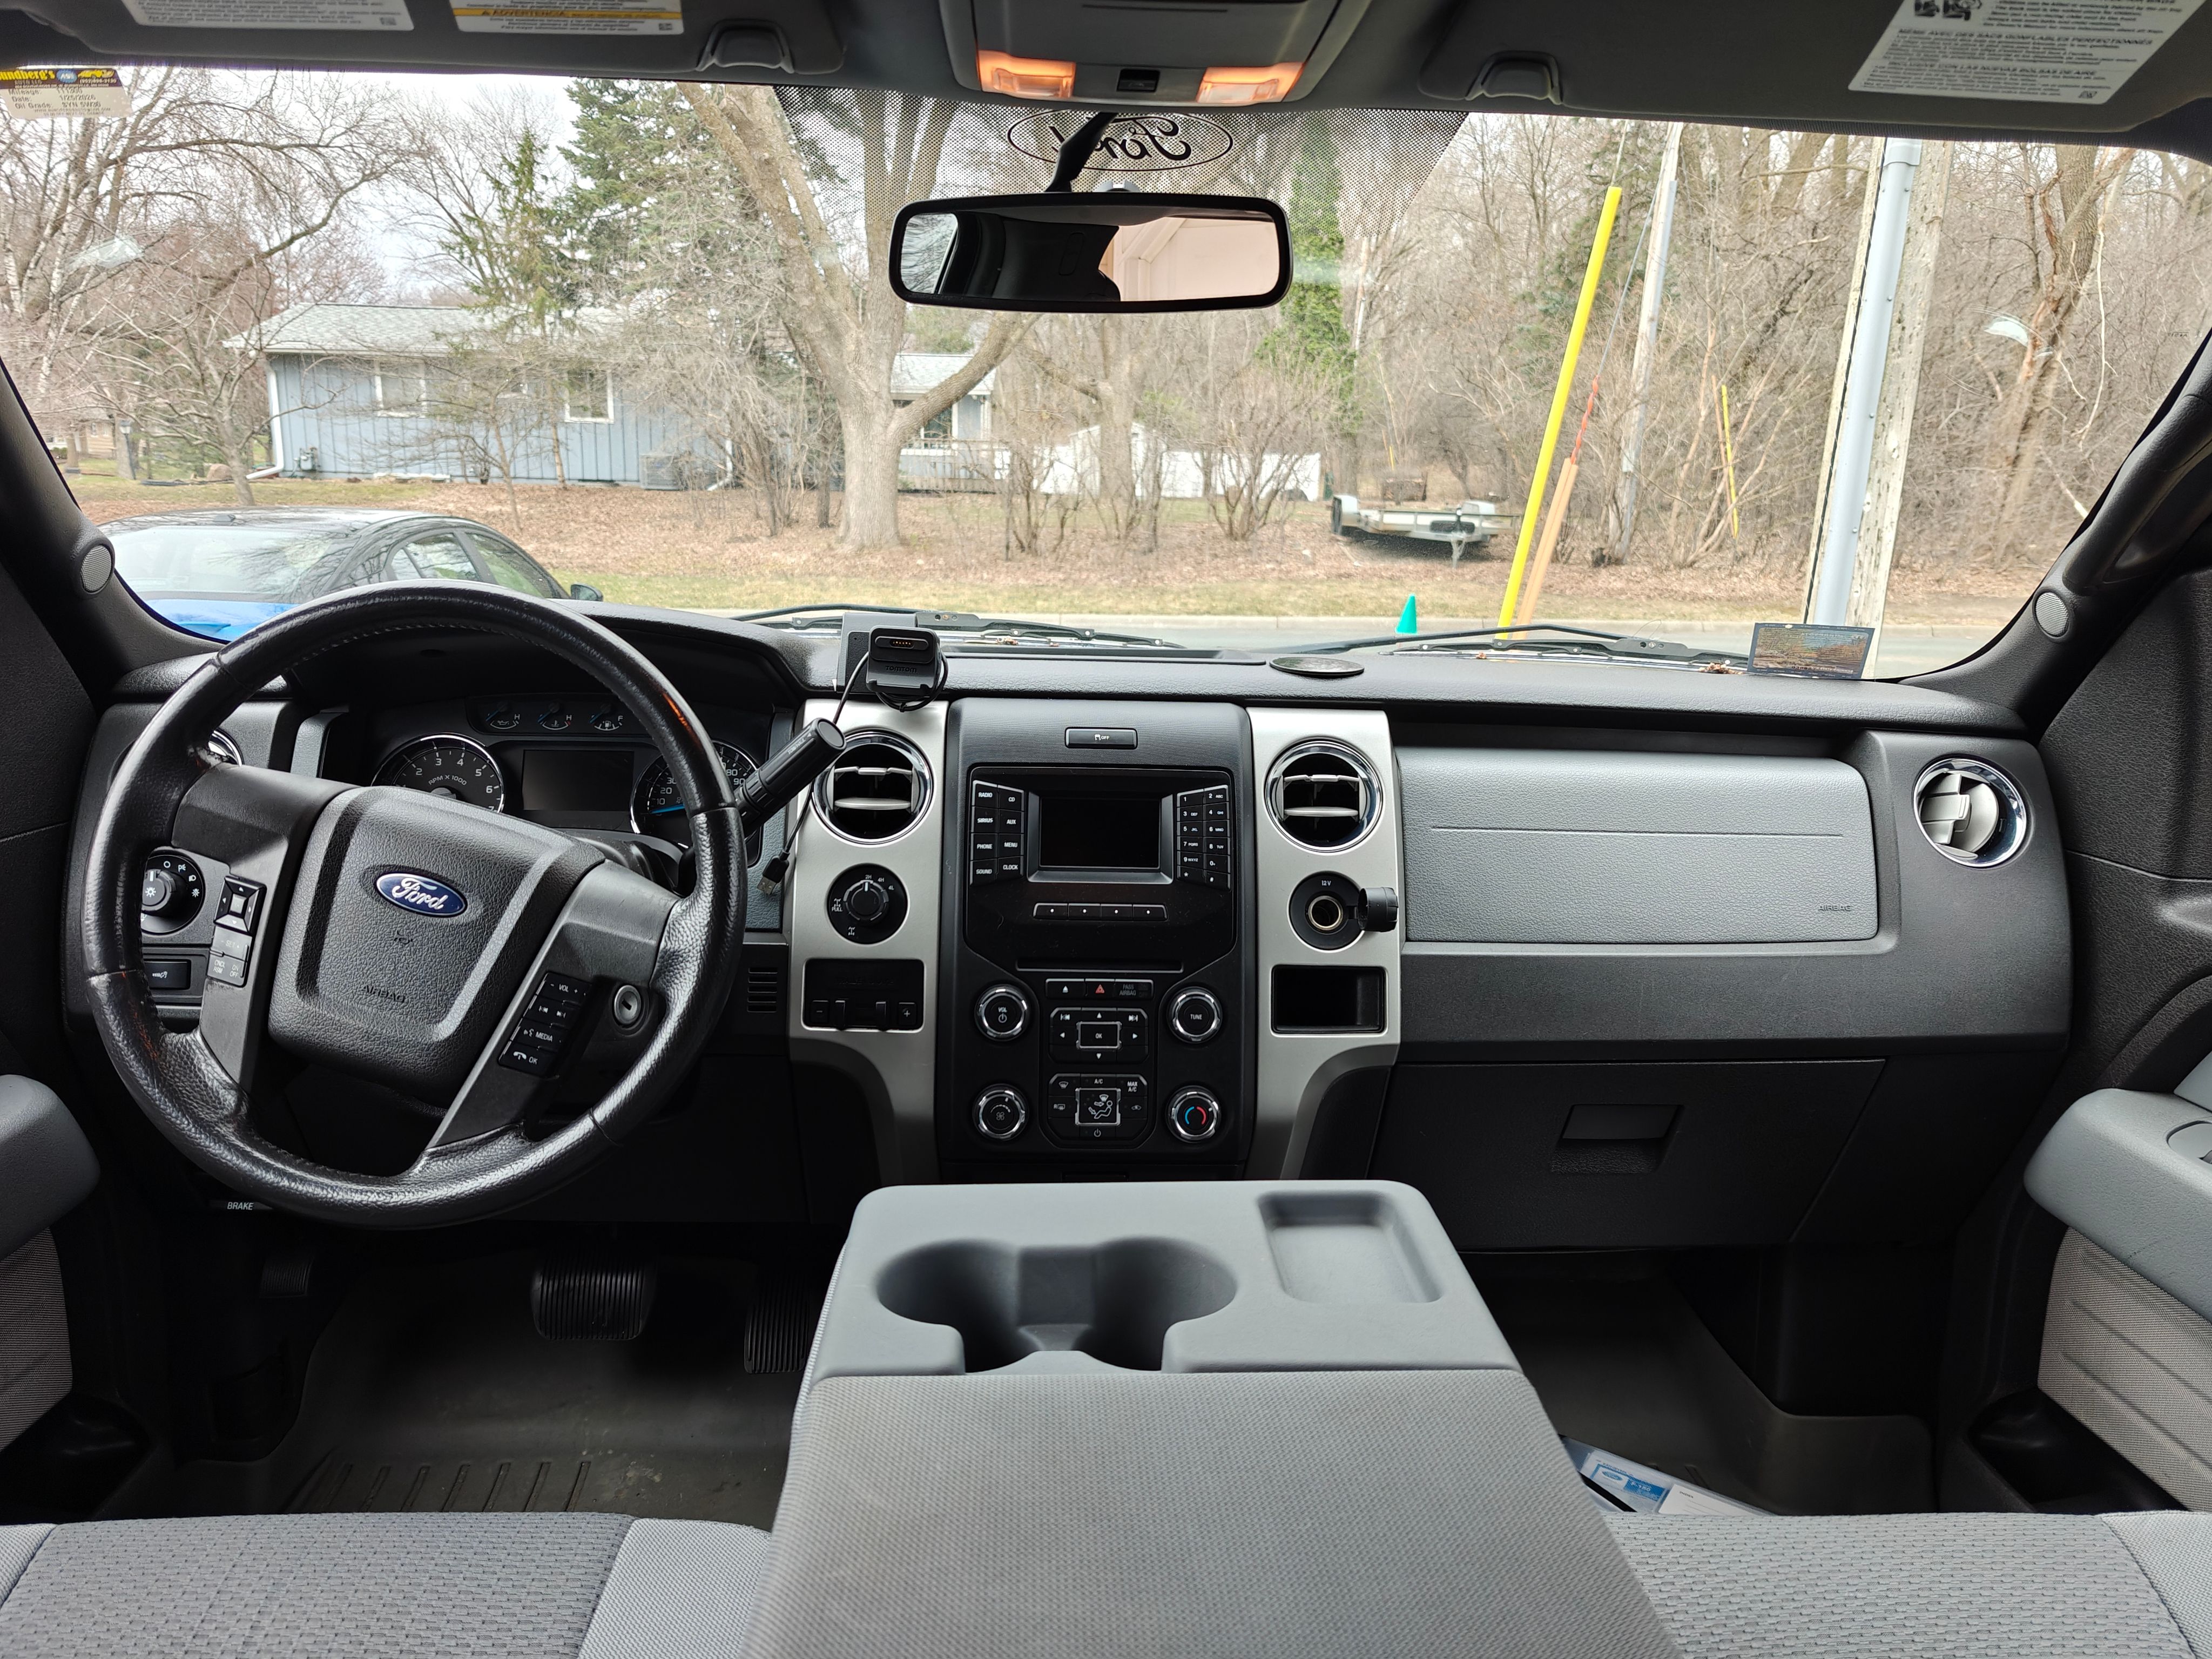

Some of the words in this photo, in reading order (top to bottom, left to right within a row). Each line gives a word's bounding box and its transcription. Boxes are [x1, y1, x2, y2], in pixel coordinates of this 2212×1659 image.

[475, 768, 482, 777] 5
[428, 775, 443, 785] RPM
[451, 775, 467, 785] 1000
[486, 785, 493, 793] 6
[392, 878, 448, 911] Ford
[559, 983, 569, 992] VOL
[535, 1031, 553, 1042] MEDIA
[529, 1056, 538, 1065] OK
[227, 1202, 254, 1210] BRAKE
